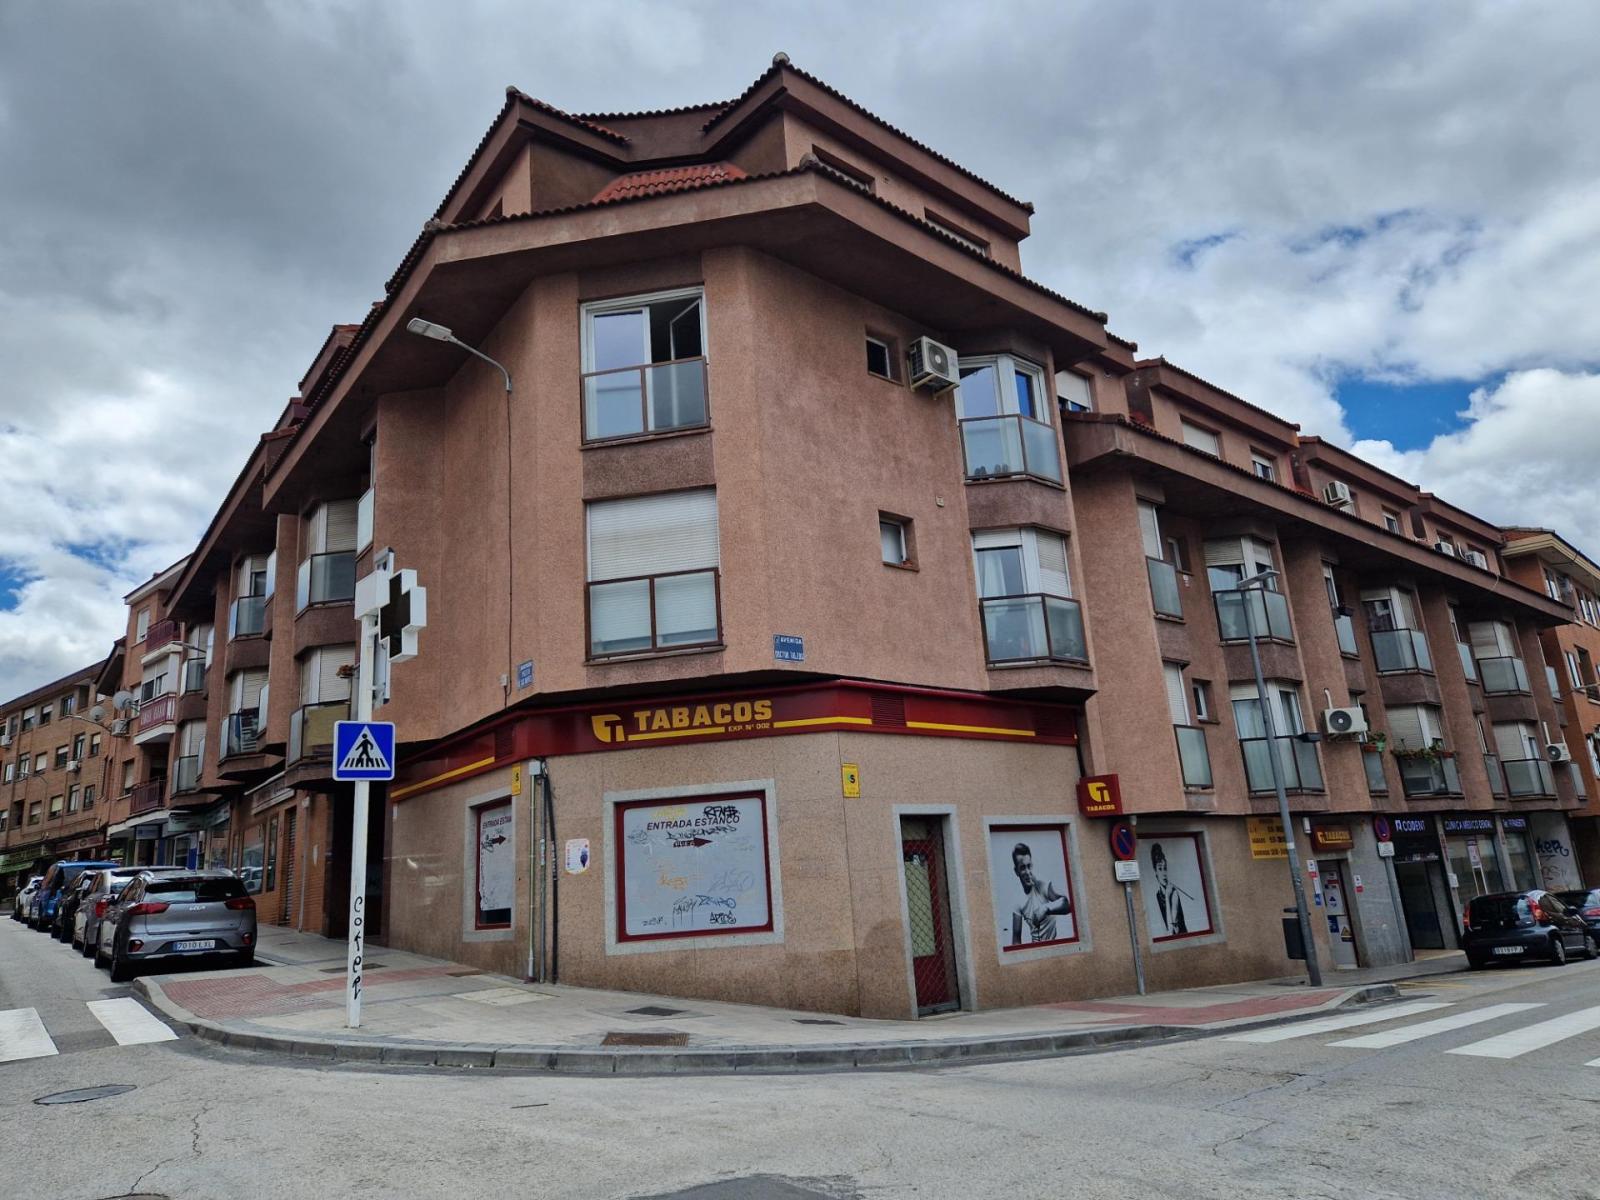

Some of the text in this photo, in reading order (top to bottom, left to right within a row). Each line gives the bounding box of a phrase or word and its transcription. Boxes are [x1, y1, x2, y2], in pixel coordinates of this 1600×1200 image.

[633, 700, 773, 731] TABACOS
[1086, 804, 1116, 812] TABACOS
[646, 814, 740, 831] ENTRADA ESTANCO
